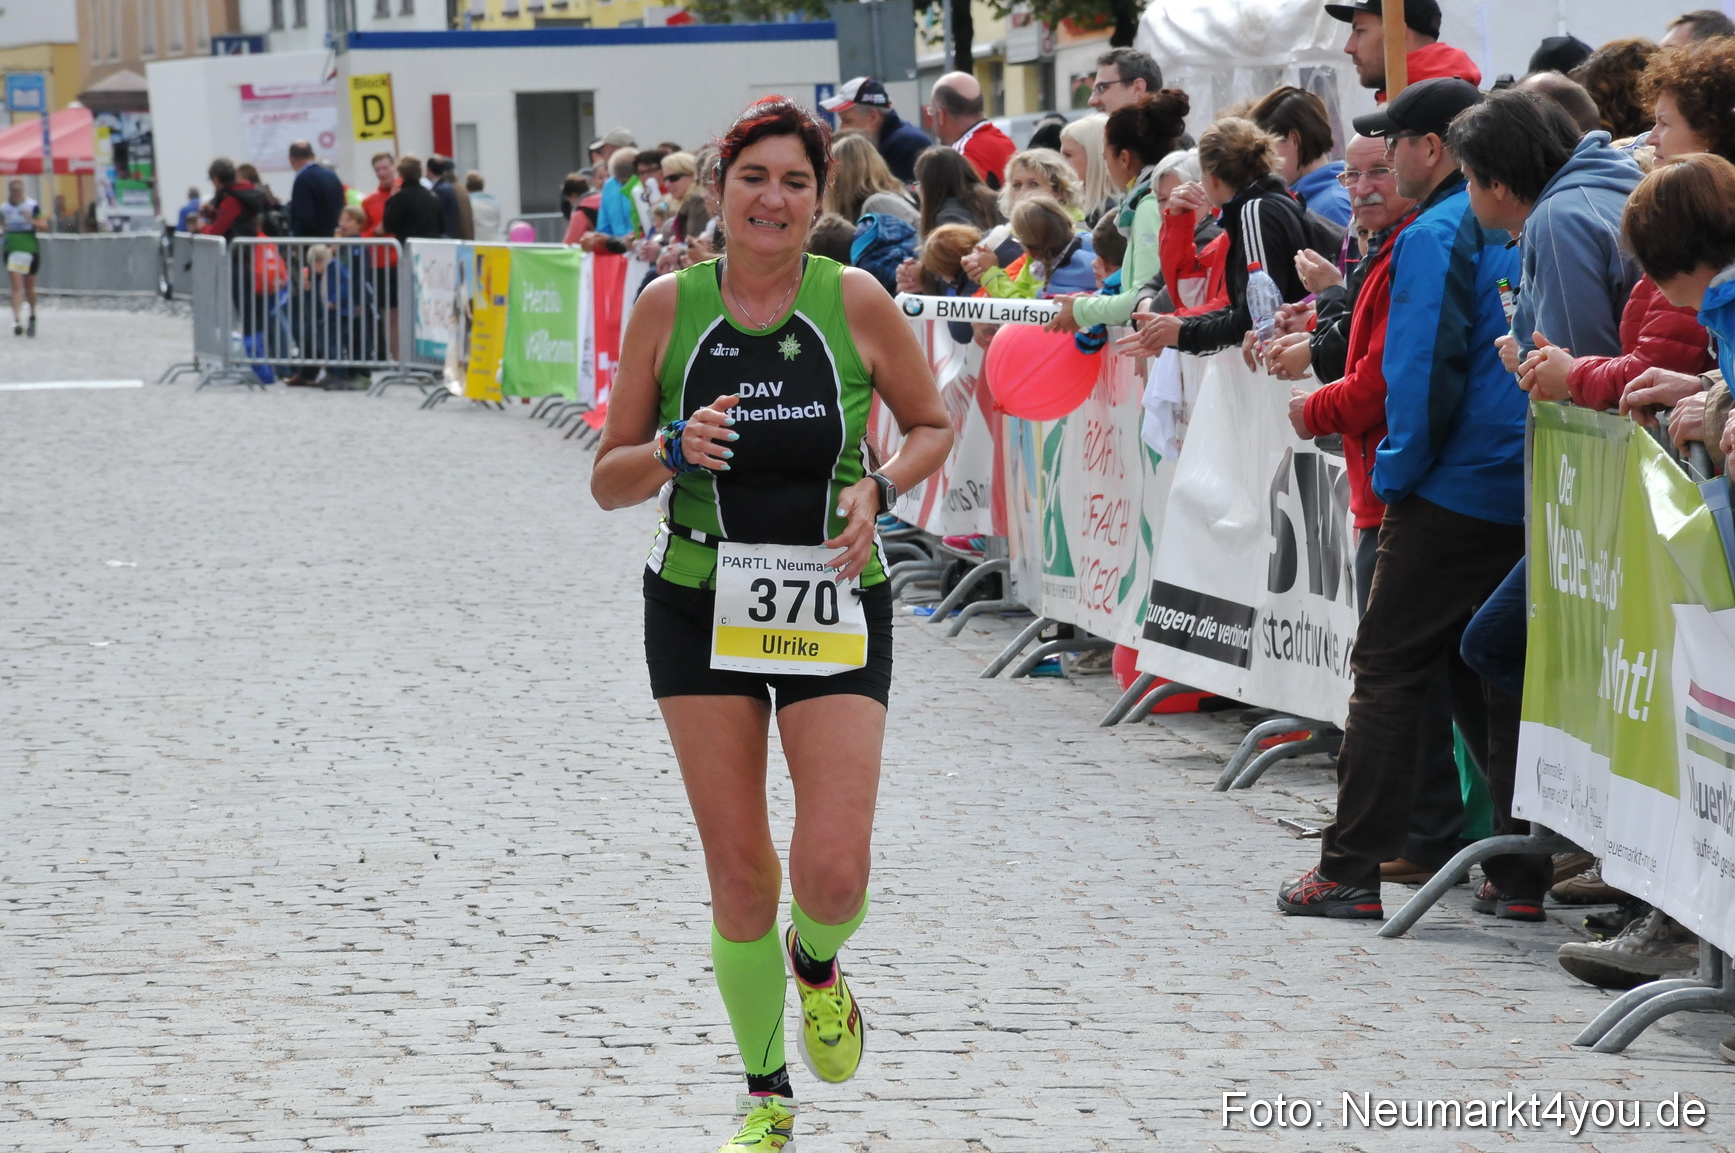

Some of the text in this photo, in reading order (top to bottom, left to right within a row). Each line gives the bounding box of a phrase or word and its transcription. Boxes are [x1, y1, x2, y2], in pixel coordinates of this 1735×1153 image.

[353, 77, 389, 90] Block
[362, 94, 385, 126] D
[936, 300, 985, 320] BMW
[739, 381, 784, 399] DAV
[1558, 453, 1577, 507] Der
[722, 555, 773, 570] PARTL
[1545, 502, 1588, 600] Neue
[747, 577, 840, 626] 370
[720, 616, 728, 626] C
[1195, 615, 1218, 641] die
[761, 634, 820, 657] Ulrike
